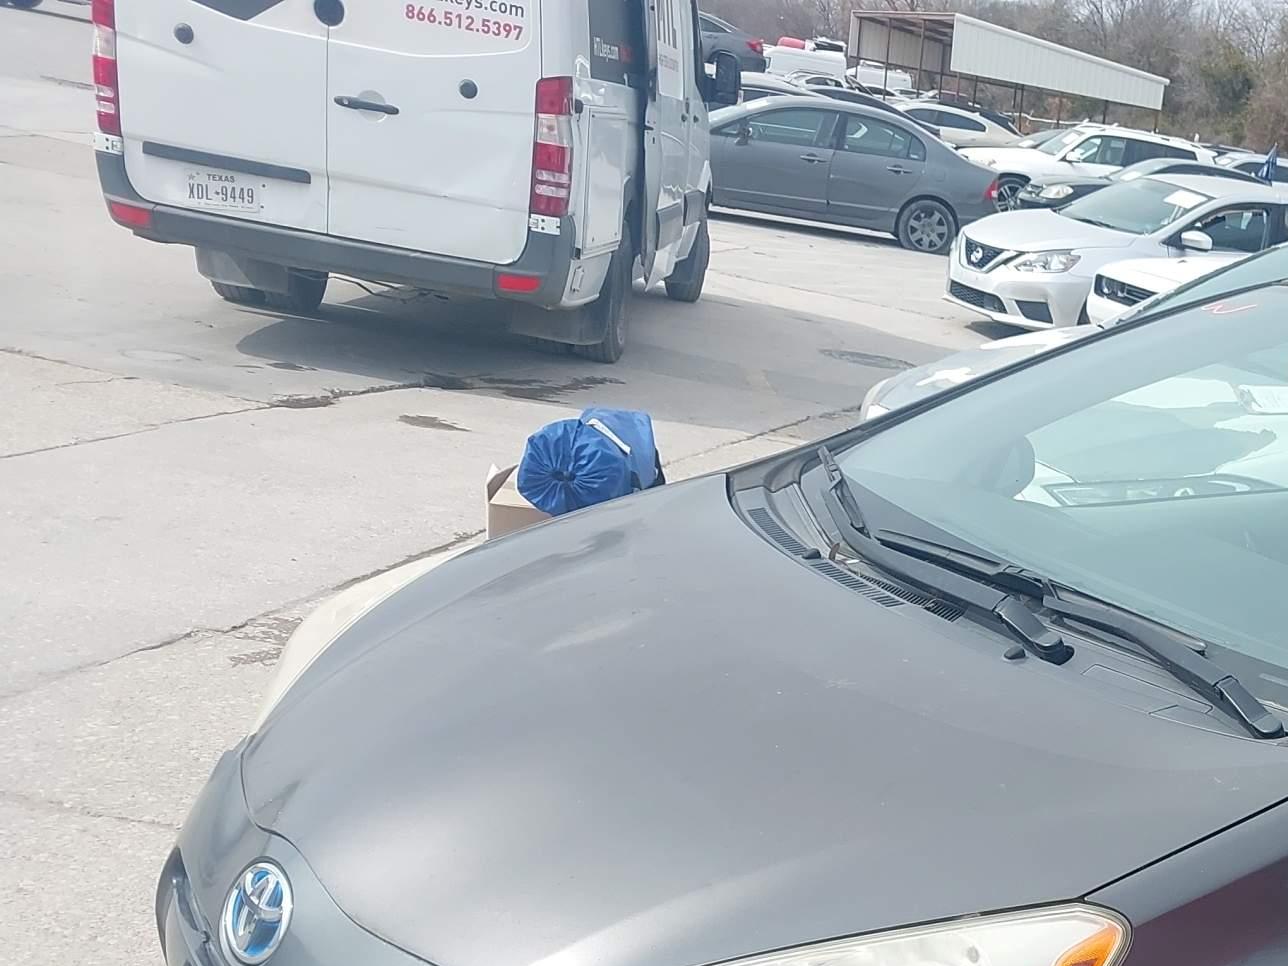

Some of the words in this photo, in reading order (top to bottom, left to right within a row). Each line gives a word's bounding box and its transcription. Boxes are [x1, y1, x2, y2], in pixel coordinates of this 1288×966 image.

[405, 3, 524, 41] 866.512.5397
[207, 173, 236, 183] TEXAS
[188, 182, 213, 200] XDL
[220, 185, 254, 205] 9449
